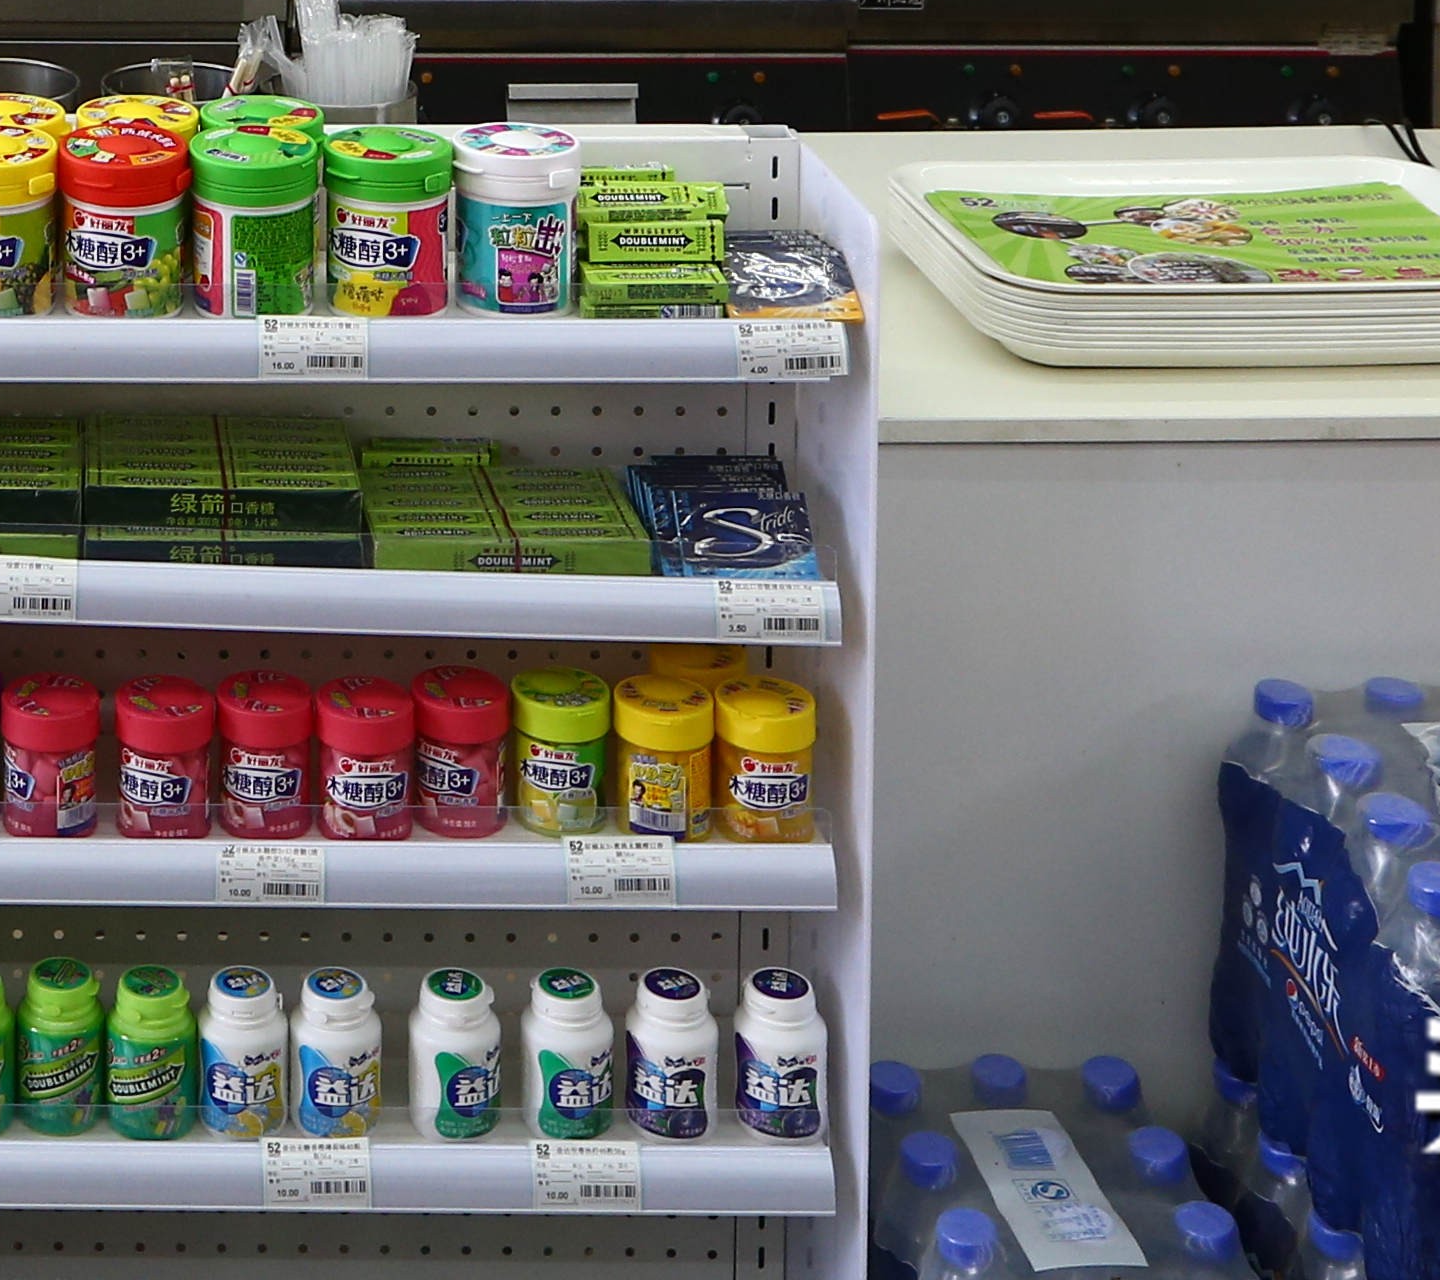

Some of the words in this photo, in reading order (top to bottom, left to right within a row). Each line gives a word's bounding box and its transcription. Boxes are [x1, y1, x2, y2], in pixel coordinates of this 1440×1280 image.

[597, 193, 664, 204] DOUBLEMINT
[620, 236, 688, 247] DOUBLEMINT
[211, 1072, 277, 1107] 益达
[633, 1071, 697, 1108] 益达
